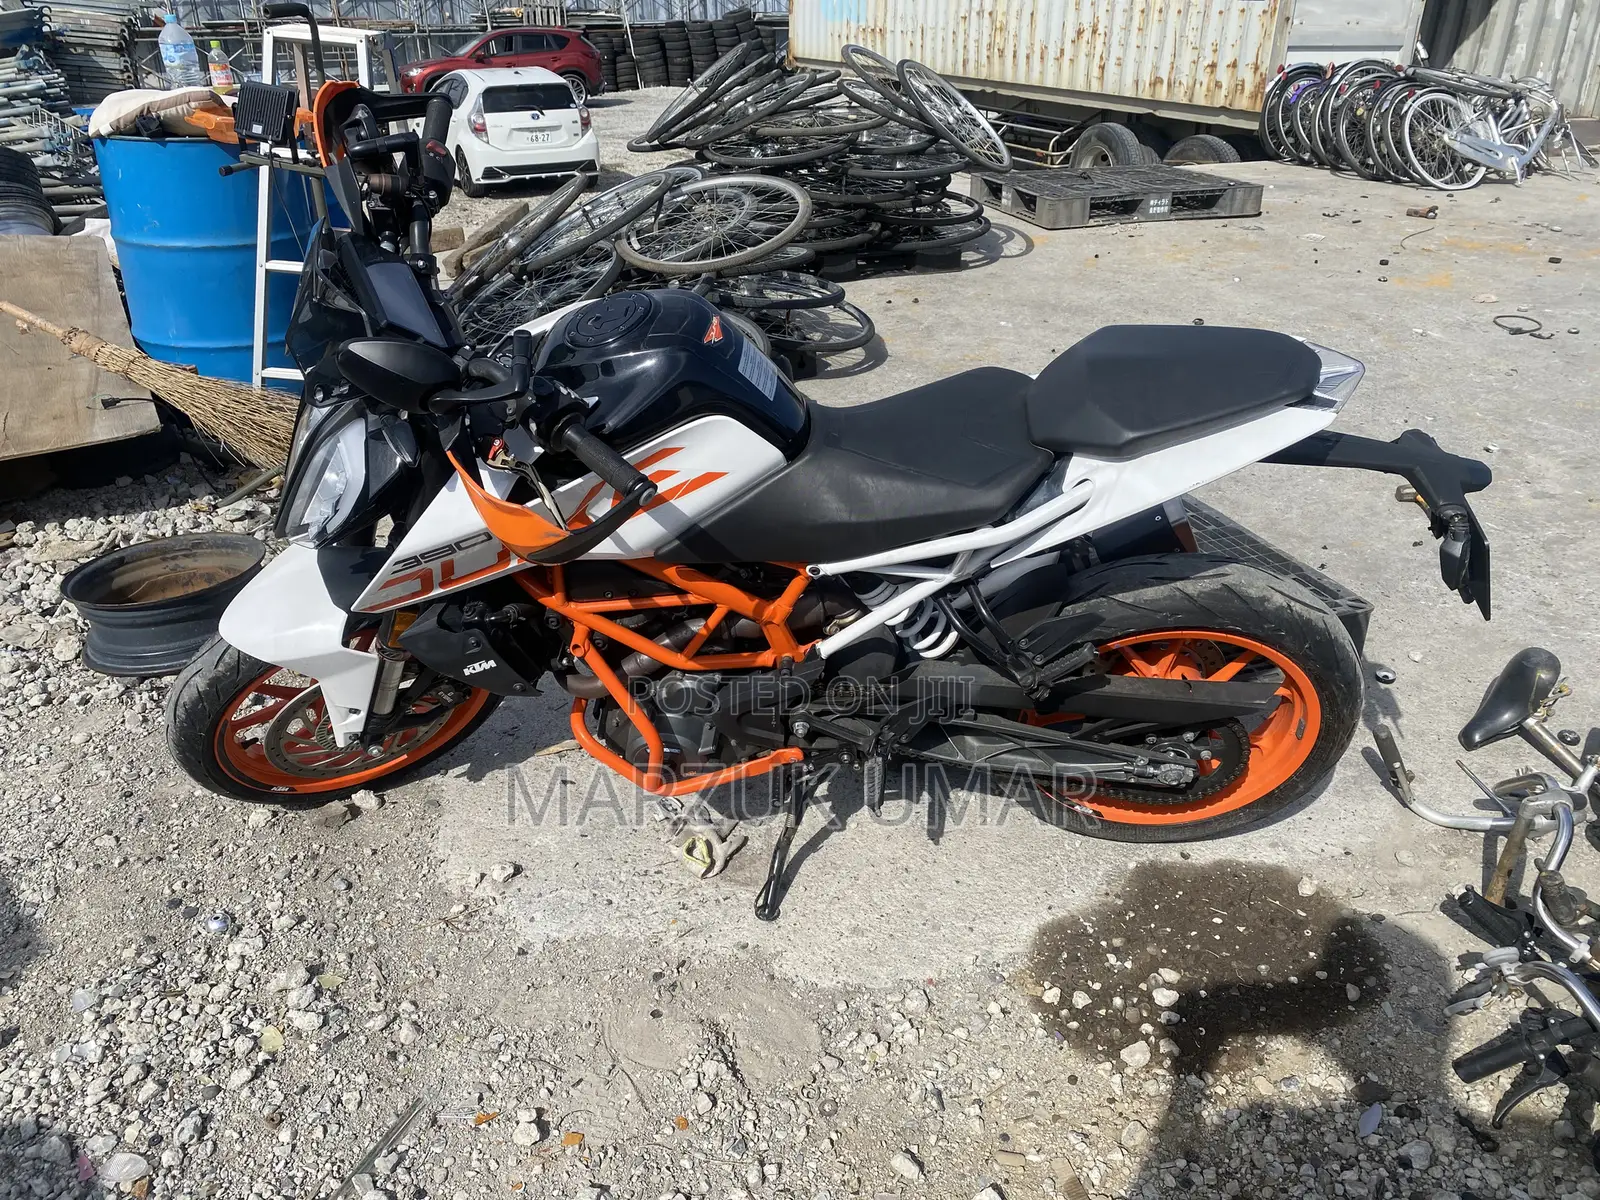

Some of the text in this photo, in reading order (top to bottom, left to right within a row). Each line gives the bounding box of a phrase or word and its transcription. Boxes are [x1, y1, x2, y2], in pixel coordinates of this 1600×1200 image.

[530, 133, 550, 143] 68-27
[390, 531, 493, 575] 390
[463, 660, 497, 676] KTM
